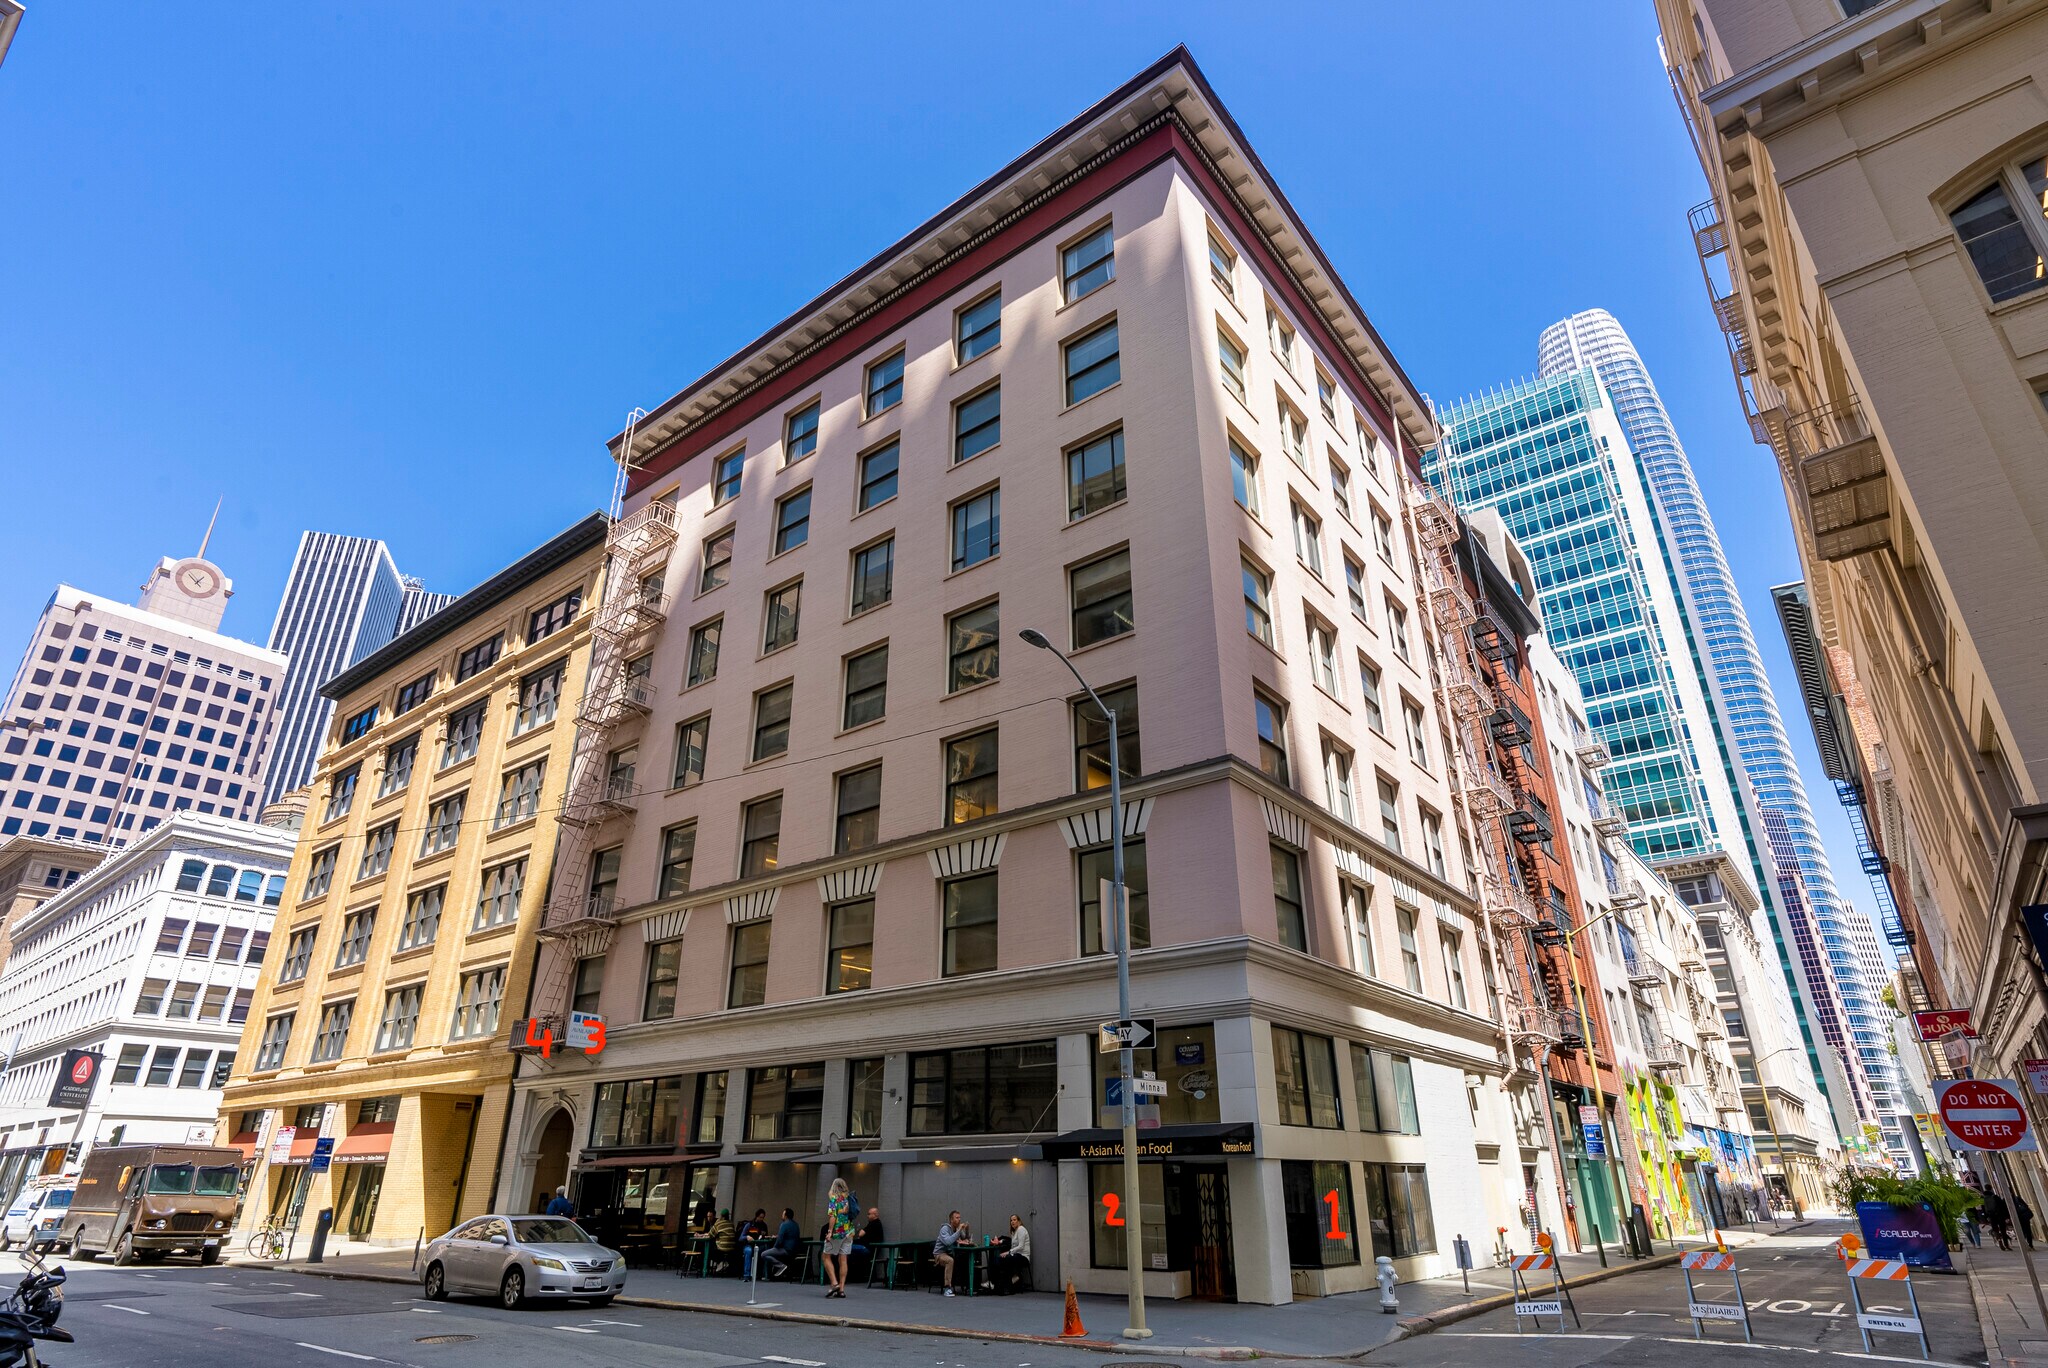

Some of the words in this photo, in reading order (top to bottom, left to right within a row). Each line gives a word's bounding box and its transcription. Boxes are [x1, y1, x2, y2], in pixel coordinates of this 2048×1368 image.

[1920, 1022, 1976, 1034] HUNAN
[1140, 1082, 1160, 1092] Minna
[1948, 1094, 1969, 1105] DO
[1977, 1093, 2007, 1105] NOT
[1963, 1125, 2013, 1136] ENTER
[1080, 1145, 1113, 1157] k-Asian
[1115, 1143, 1147, 1156] Koan
[1149, 1142, 1173, 1154] Food
[1222, 1142, 1239, 1153] Korean
[1239, 1142, 1252, 1152] Food
[1532, 1304, 1560, 1312] MINNA
